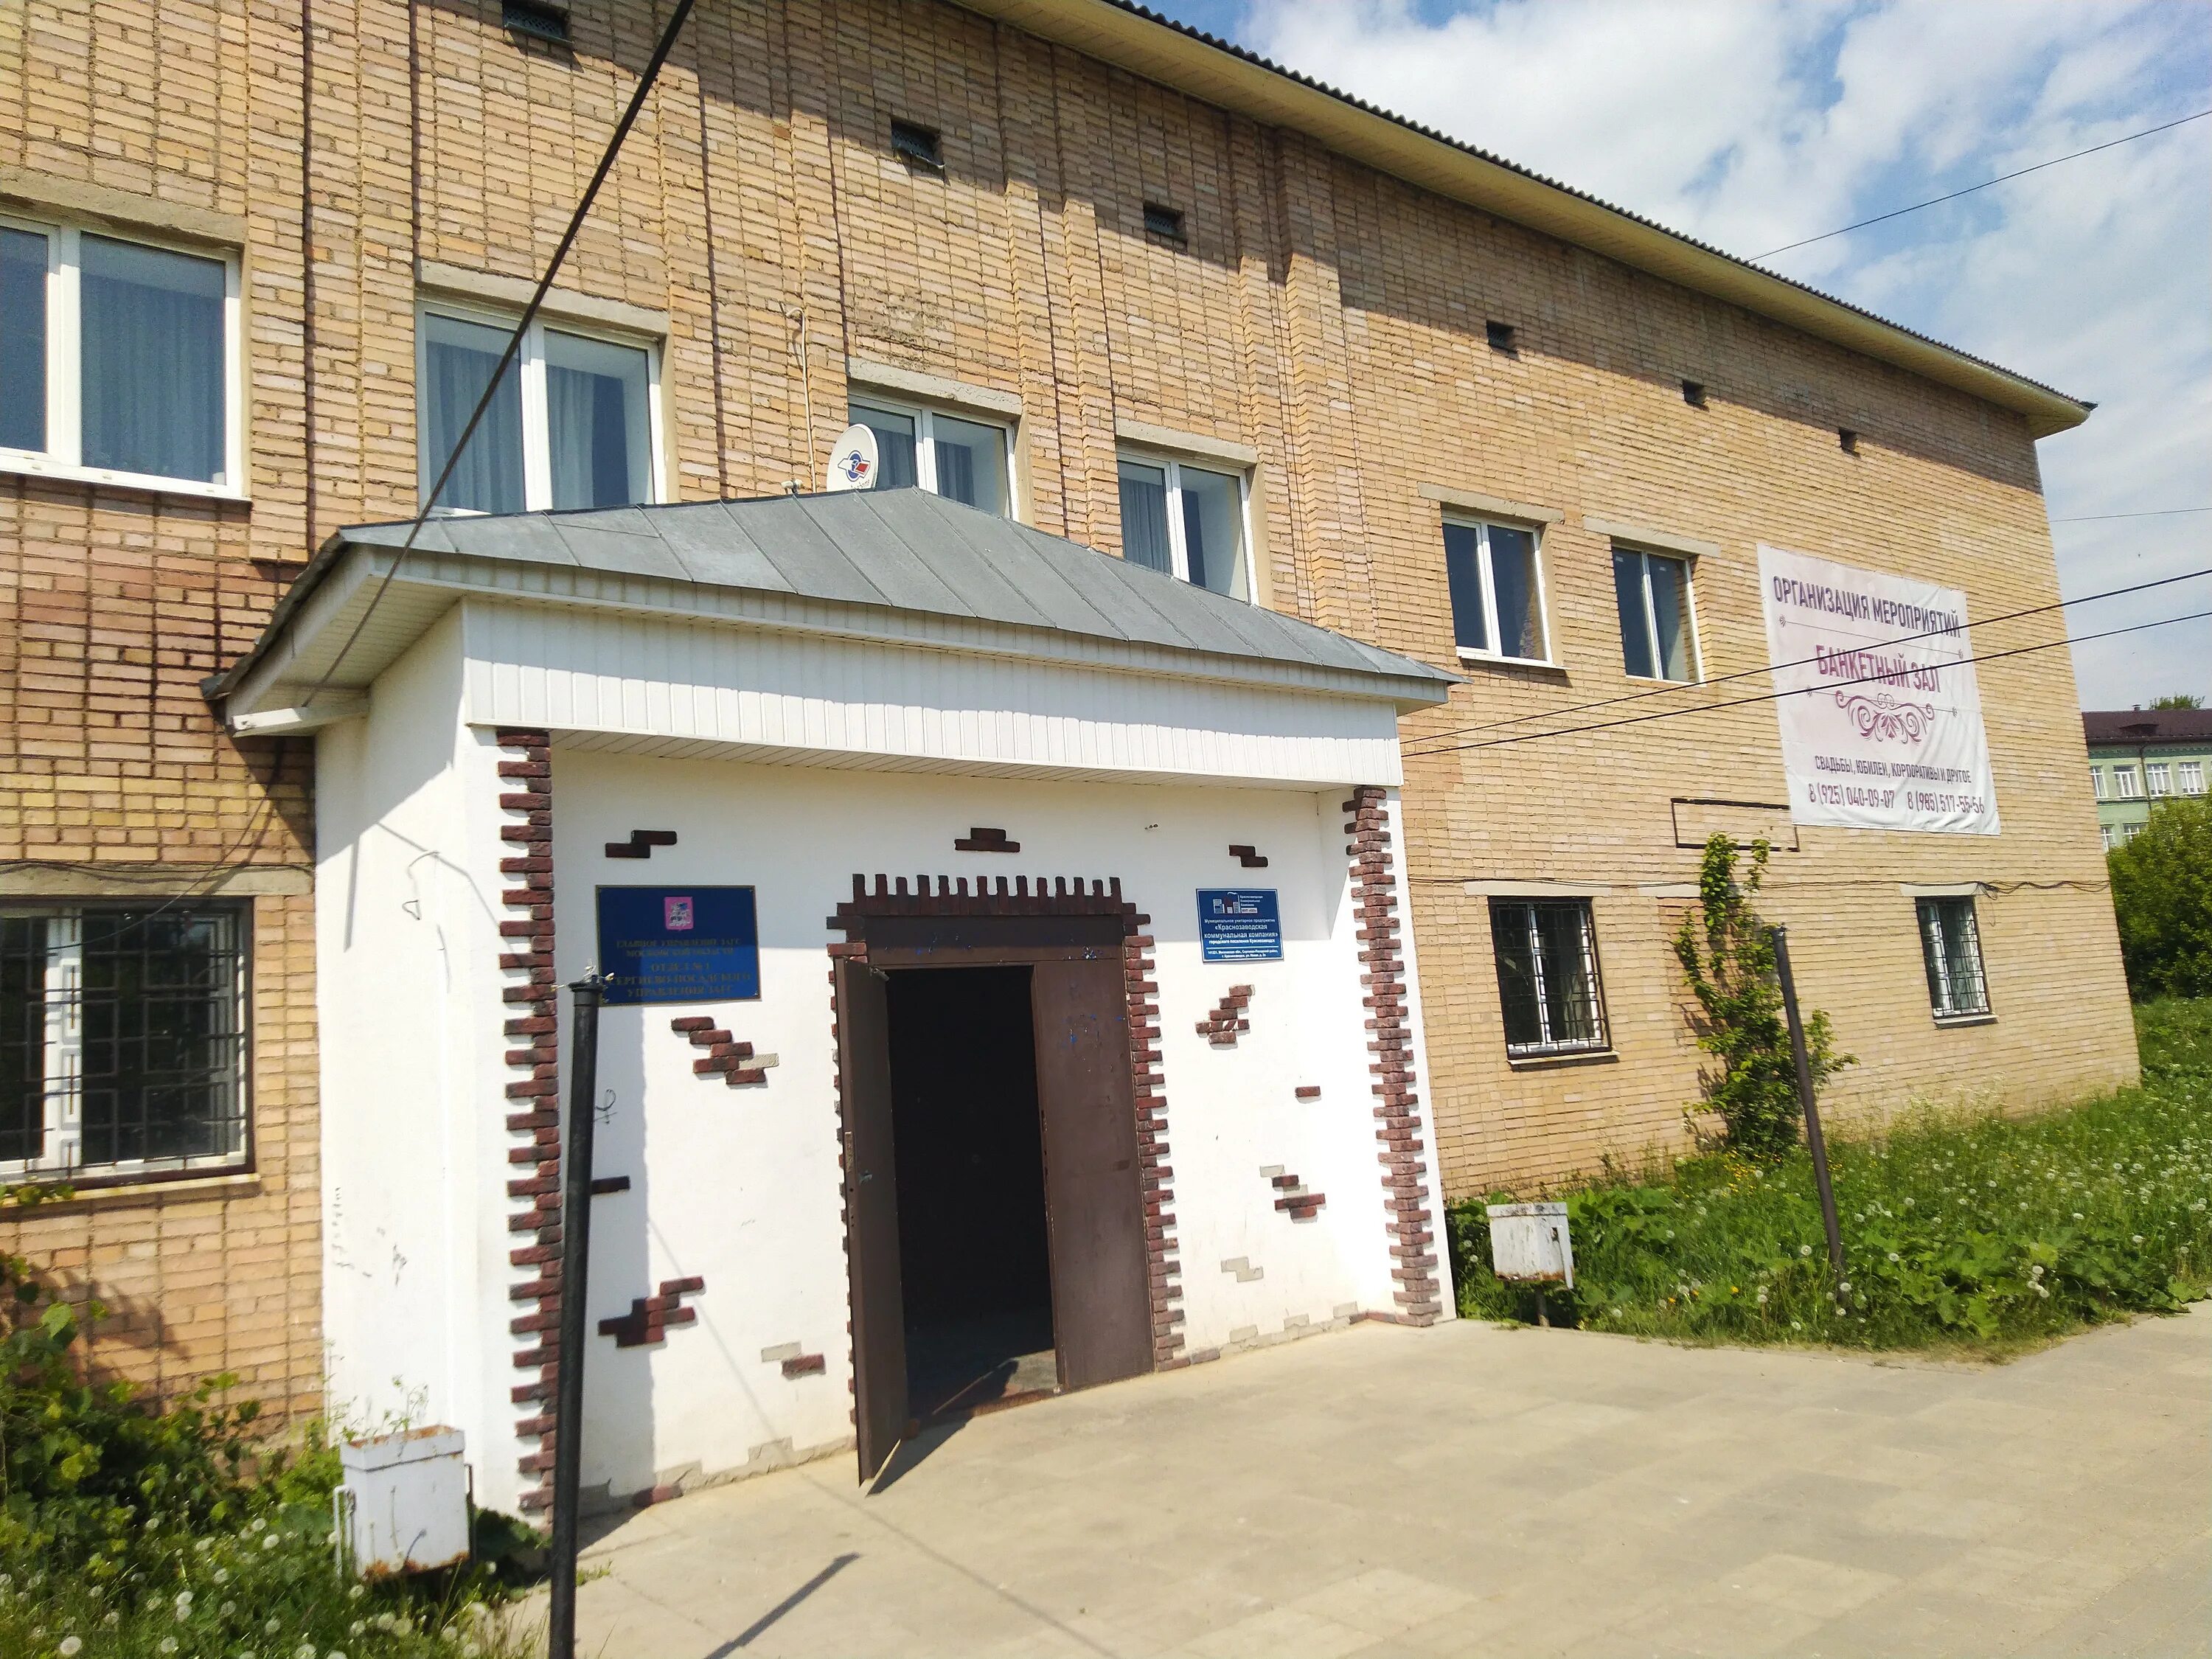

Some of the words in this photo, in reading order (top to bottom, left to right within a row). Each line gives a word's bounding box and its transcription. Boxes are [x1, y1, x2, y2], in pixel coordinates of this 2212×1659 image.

[1773, 575, 1870, 622] ОРГАНИЗАЦИЯ
[1872, 597, 1961, 639] МЕРОПРИЯТИЙ
[1815, 644, 1910, 689] БАНКЕТНЫЙ
[1910, 661, 1941, 693] ЗАЛ
[1815, 755, 1855, 775] СВАДЬБЫ,
[1891, 762, 1940, 781] КОРПОРАТИВЫ
[1946, 768, 1972, 785] ДРУГОЕ
[1809, 783, 1816, 803] 8
[1817, 782, 1845, 807] (925)
[1846, 786, 1895, 808] 040-09-07
[1907, 791, 1913, 810] 8
[1915, 790, 1938, 813] (985)
[1939, 794, 1984, 814] 517-55-56
